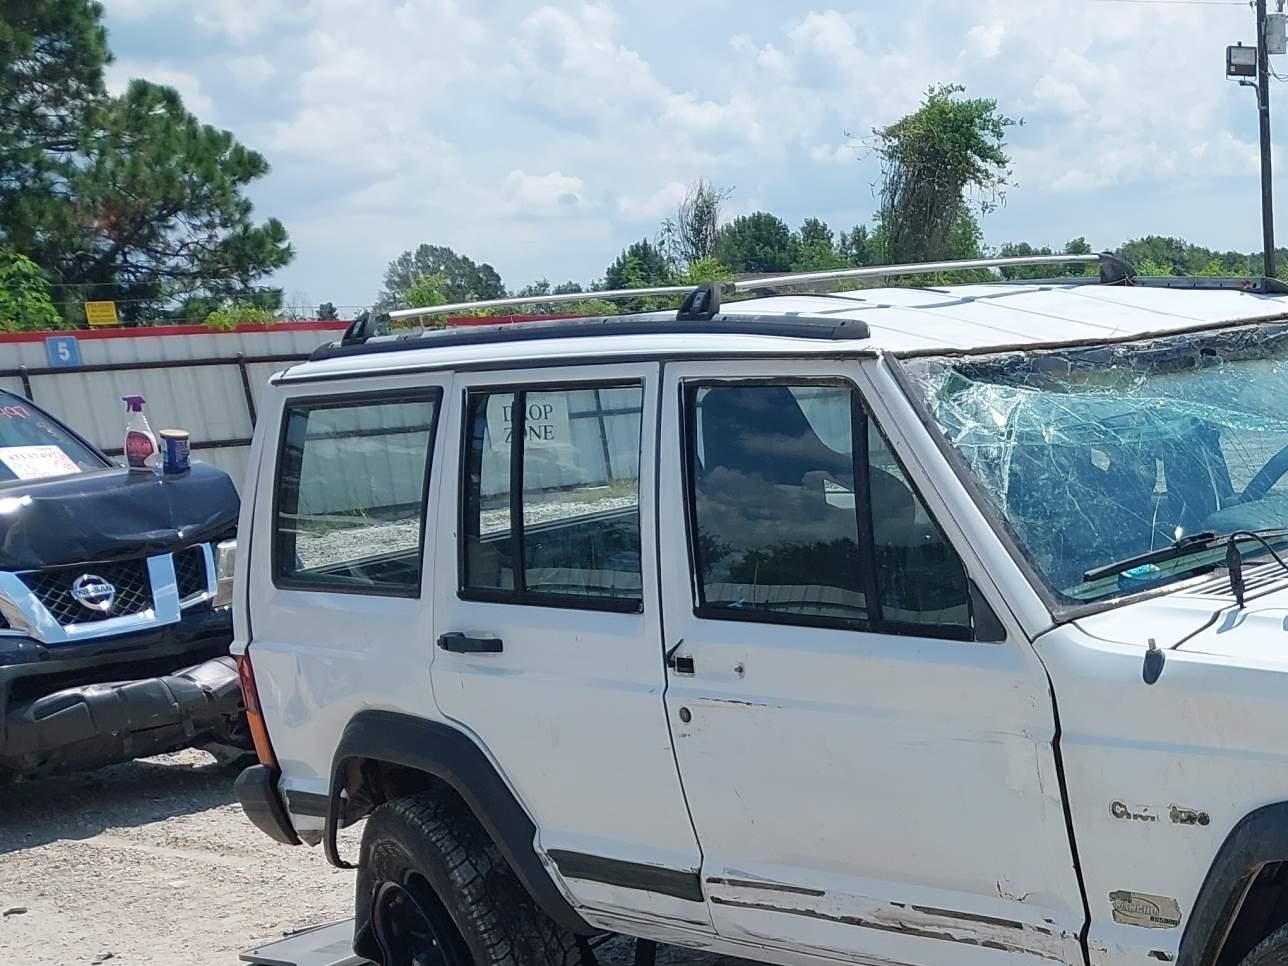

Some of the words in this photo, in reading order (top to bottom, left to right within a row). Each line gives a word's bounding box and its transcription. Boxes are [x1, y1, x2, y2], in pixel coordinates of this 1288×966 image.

[57, 342, 71, 361] 5
[503, 403, 554, 422] DOP
[504, 424, 555, 444] ZNE
